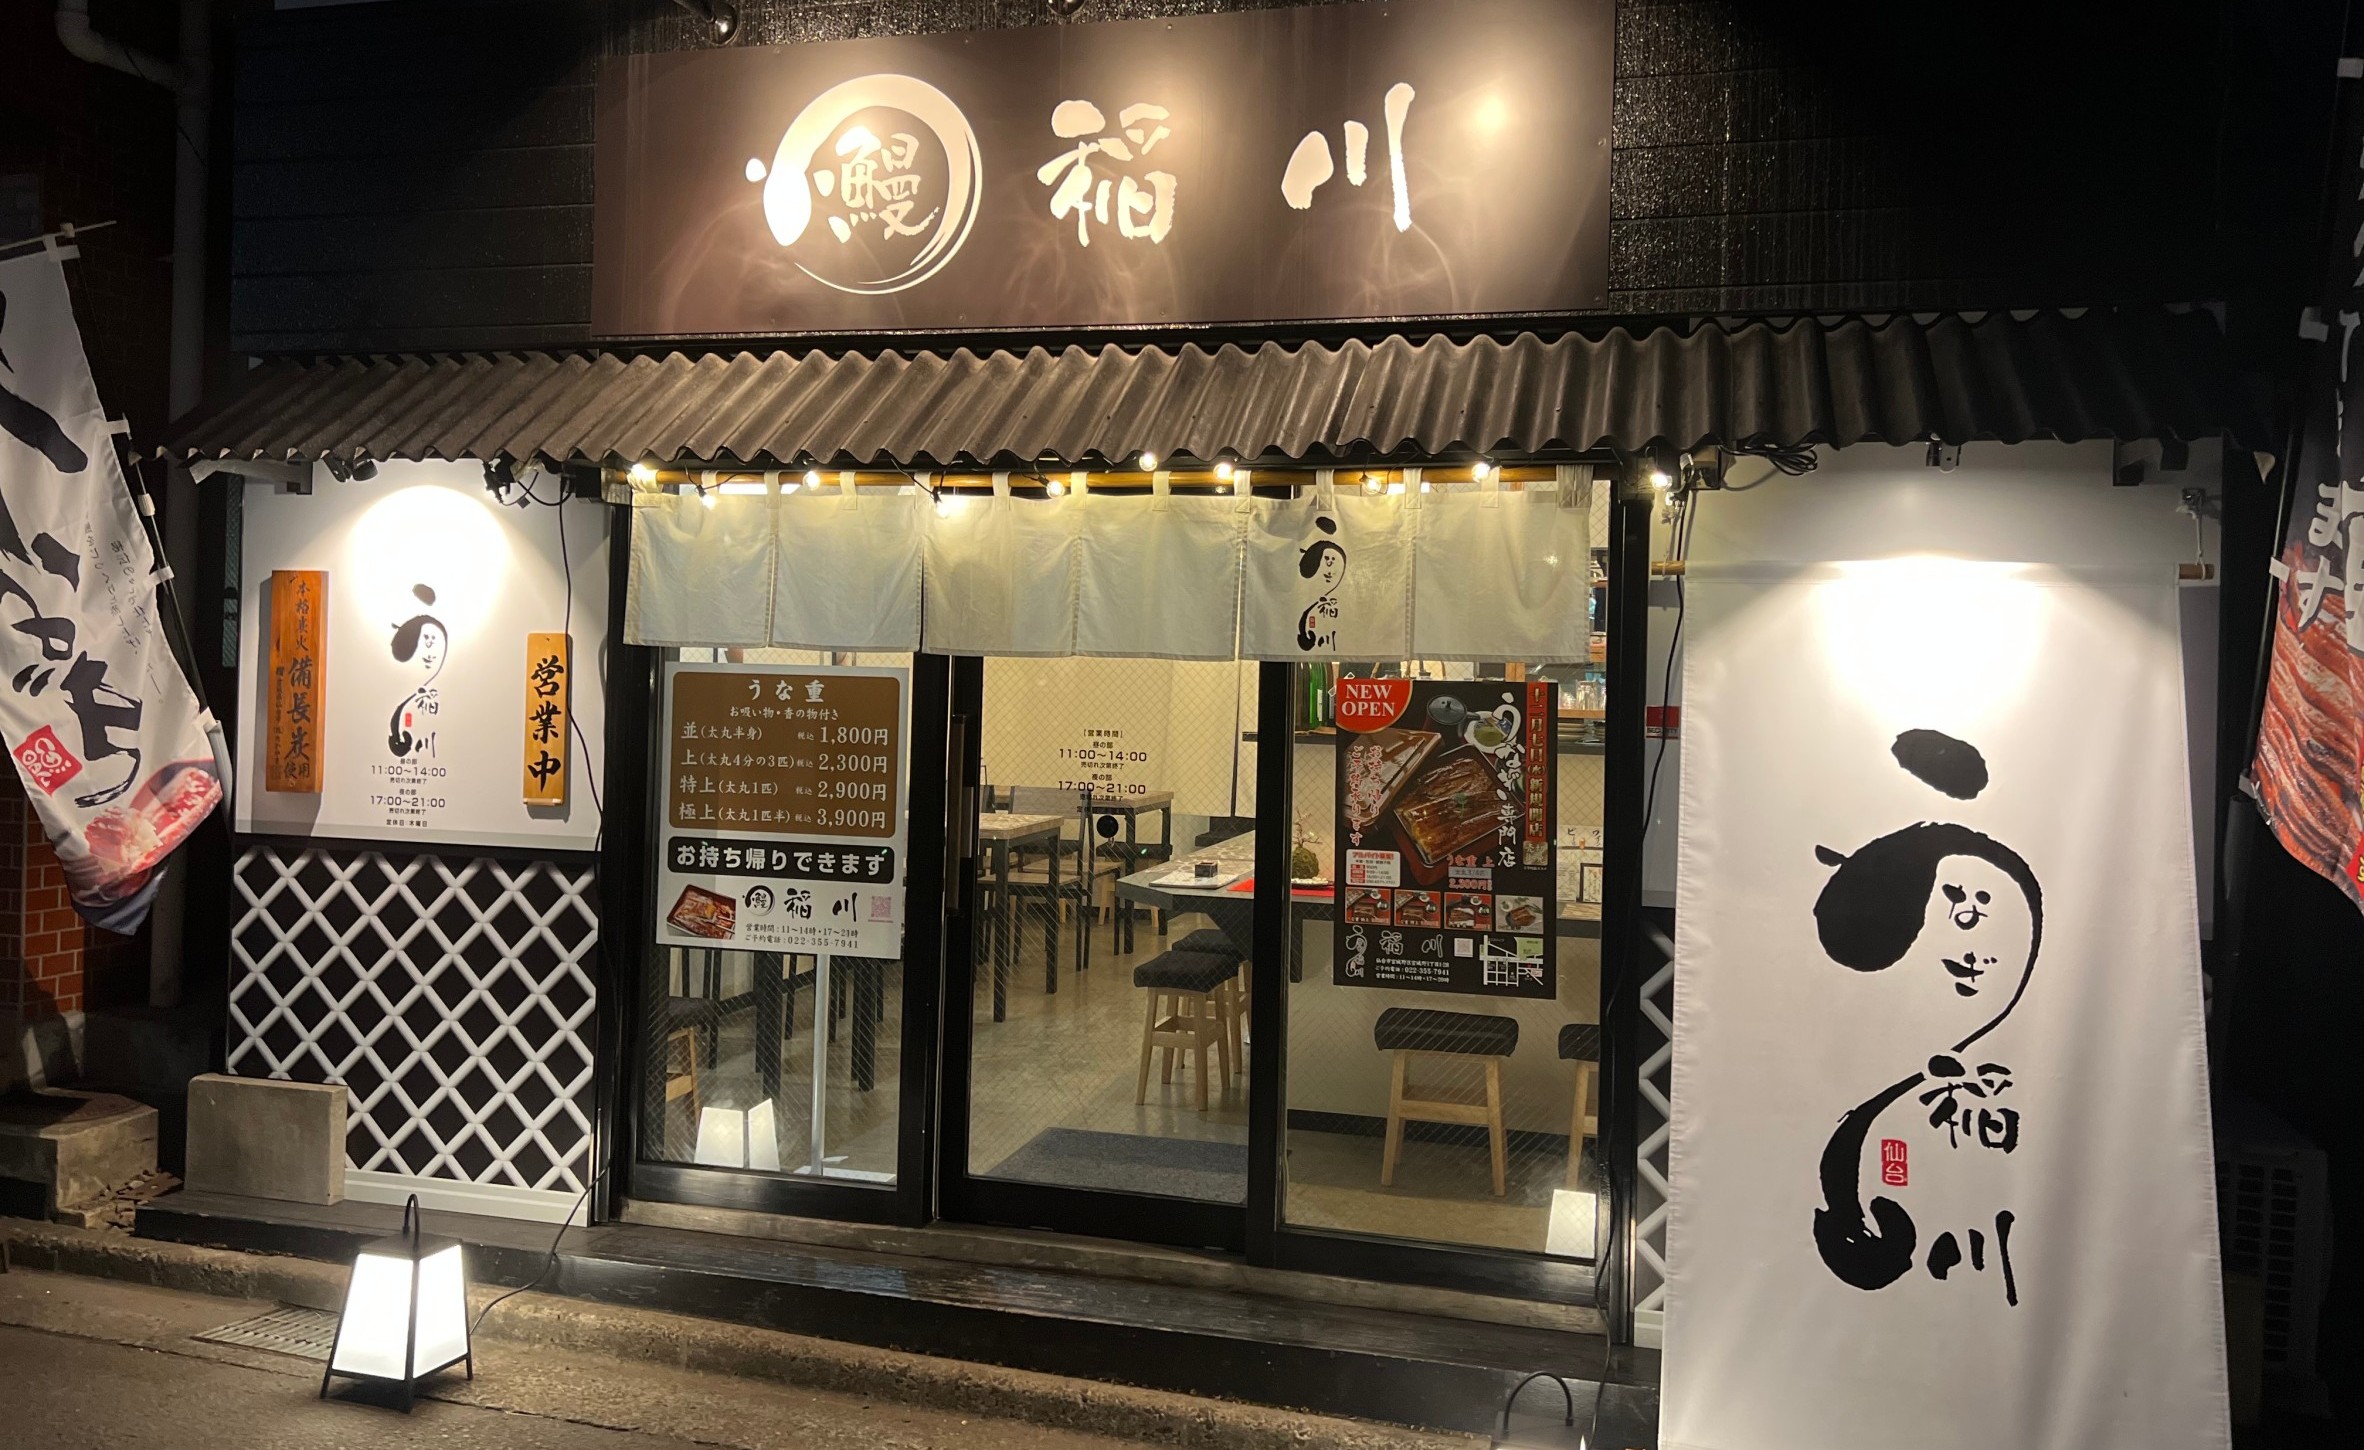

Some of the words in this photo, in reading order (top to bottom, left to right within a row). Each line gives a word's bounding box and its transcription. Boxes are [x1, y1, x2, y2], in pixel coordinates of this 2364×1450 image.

[1036, 82, 1416, 248] 稲川
[749, 680, 825, 703] うな重
[1345, 684, 1392, 699] NEW
[1341, 701, 1395, 717] OPEN
[527, 655, 564, 792] 営業中
[820, 726, 889, 746] 1,800円
[818, 753, 888, 774] 2,300円
[817, 780, 887, 801] 2,900円
[816, 808, 886, 829] 3,900円
[676, 845, 885, 876] お持ち帰りできます
